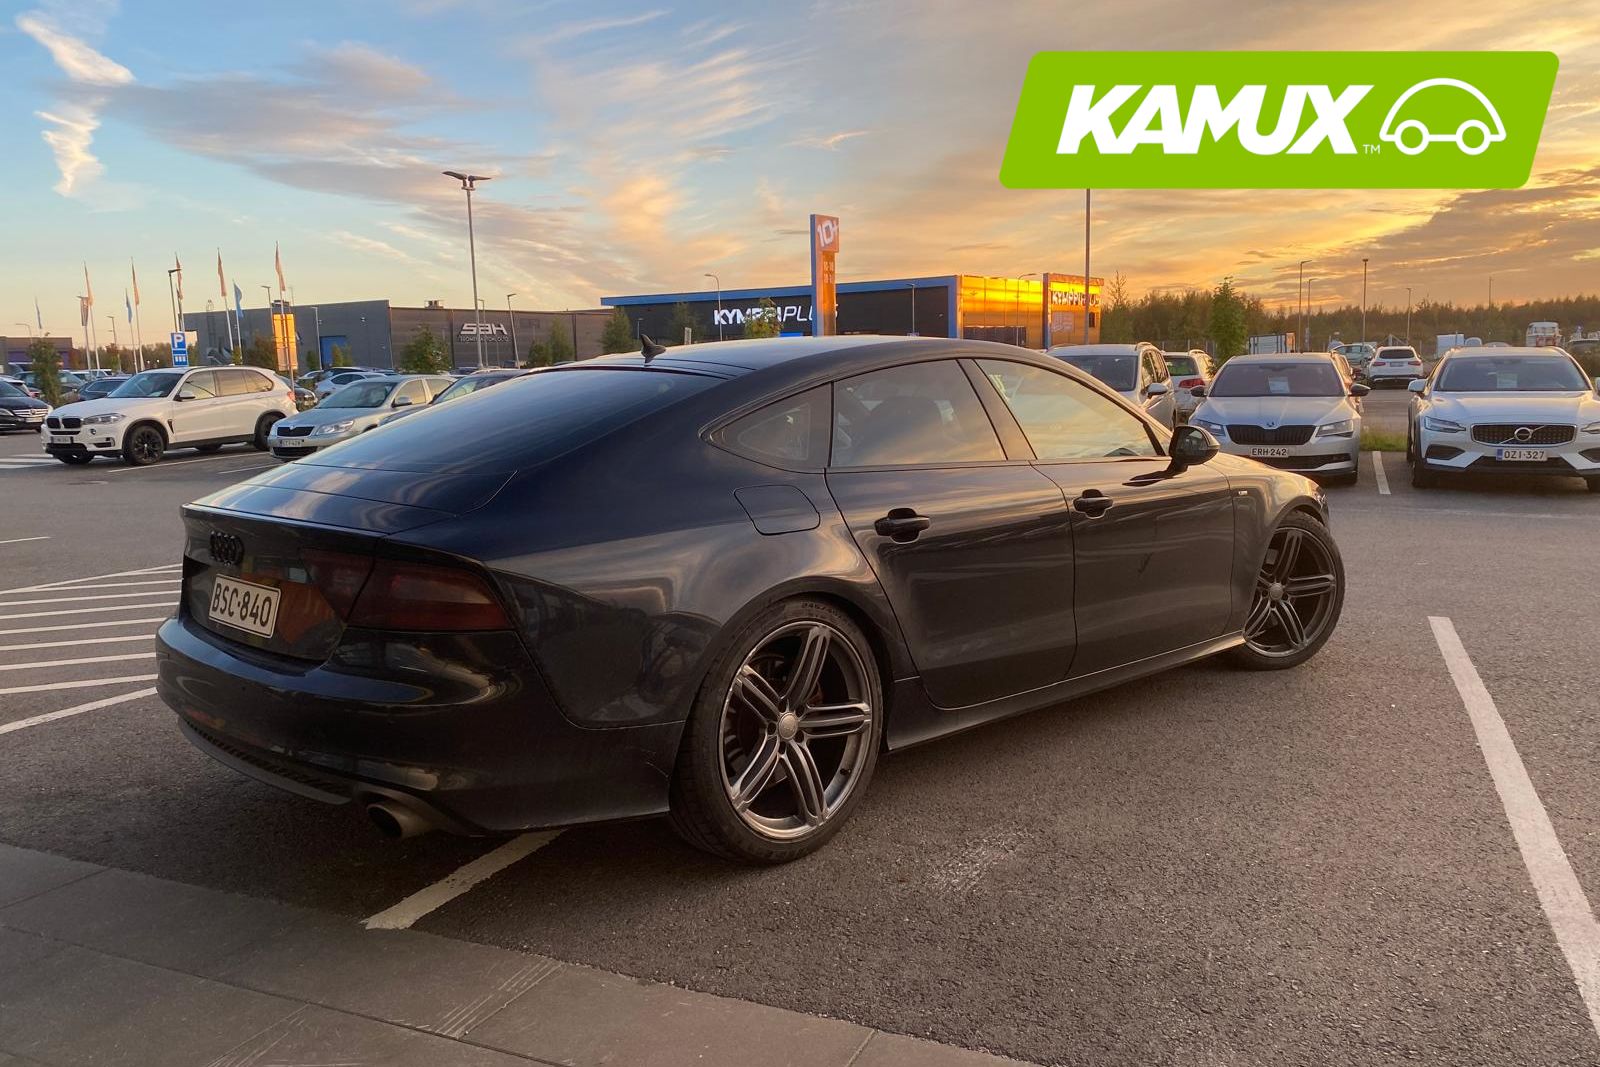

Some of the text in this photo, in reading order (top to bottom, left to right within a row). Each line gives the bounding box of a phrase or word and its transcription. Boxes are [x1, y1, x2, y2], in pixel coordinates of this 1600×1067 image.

[816, 219, 838, 248] 10+
[173, 333, 184, 348] P
[1251, 448, 1287, 456] ERH-242
[1504, 450, 1545, 460] OZI-327
[211, 583, 272, 627] BSC-840
